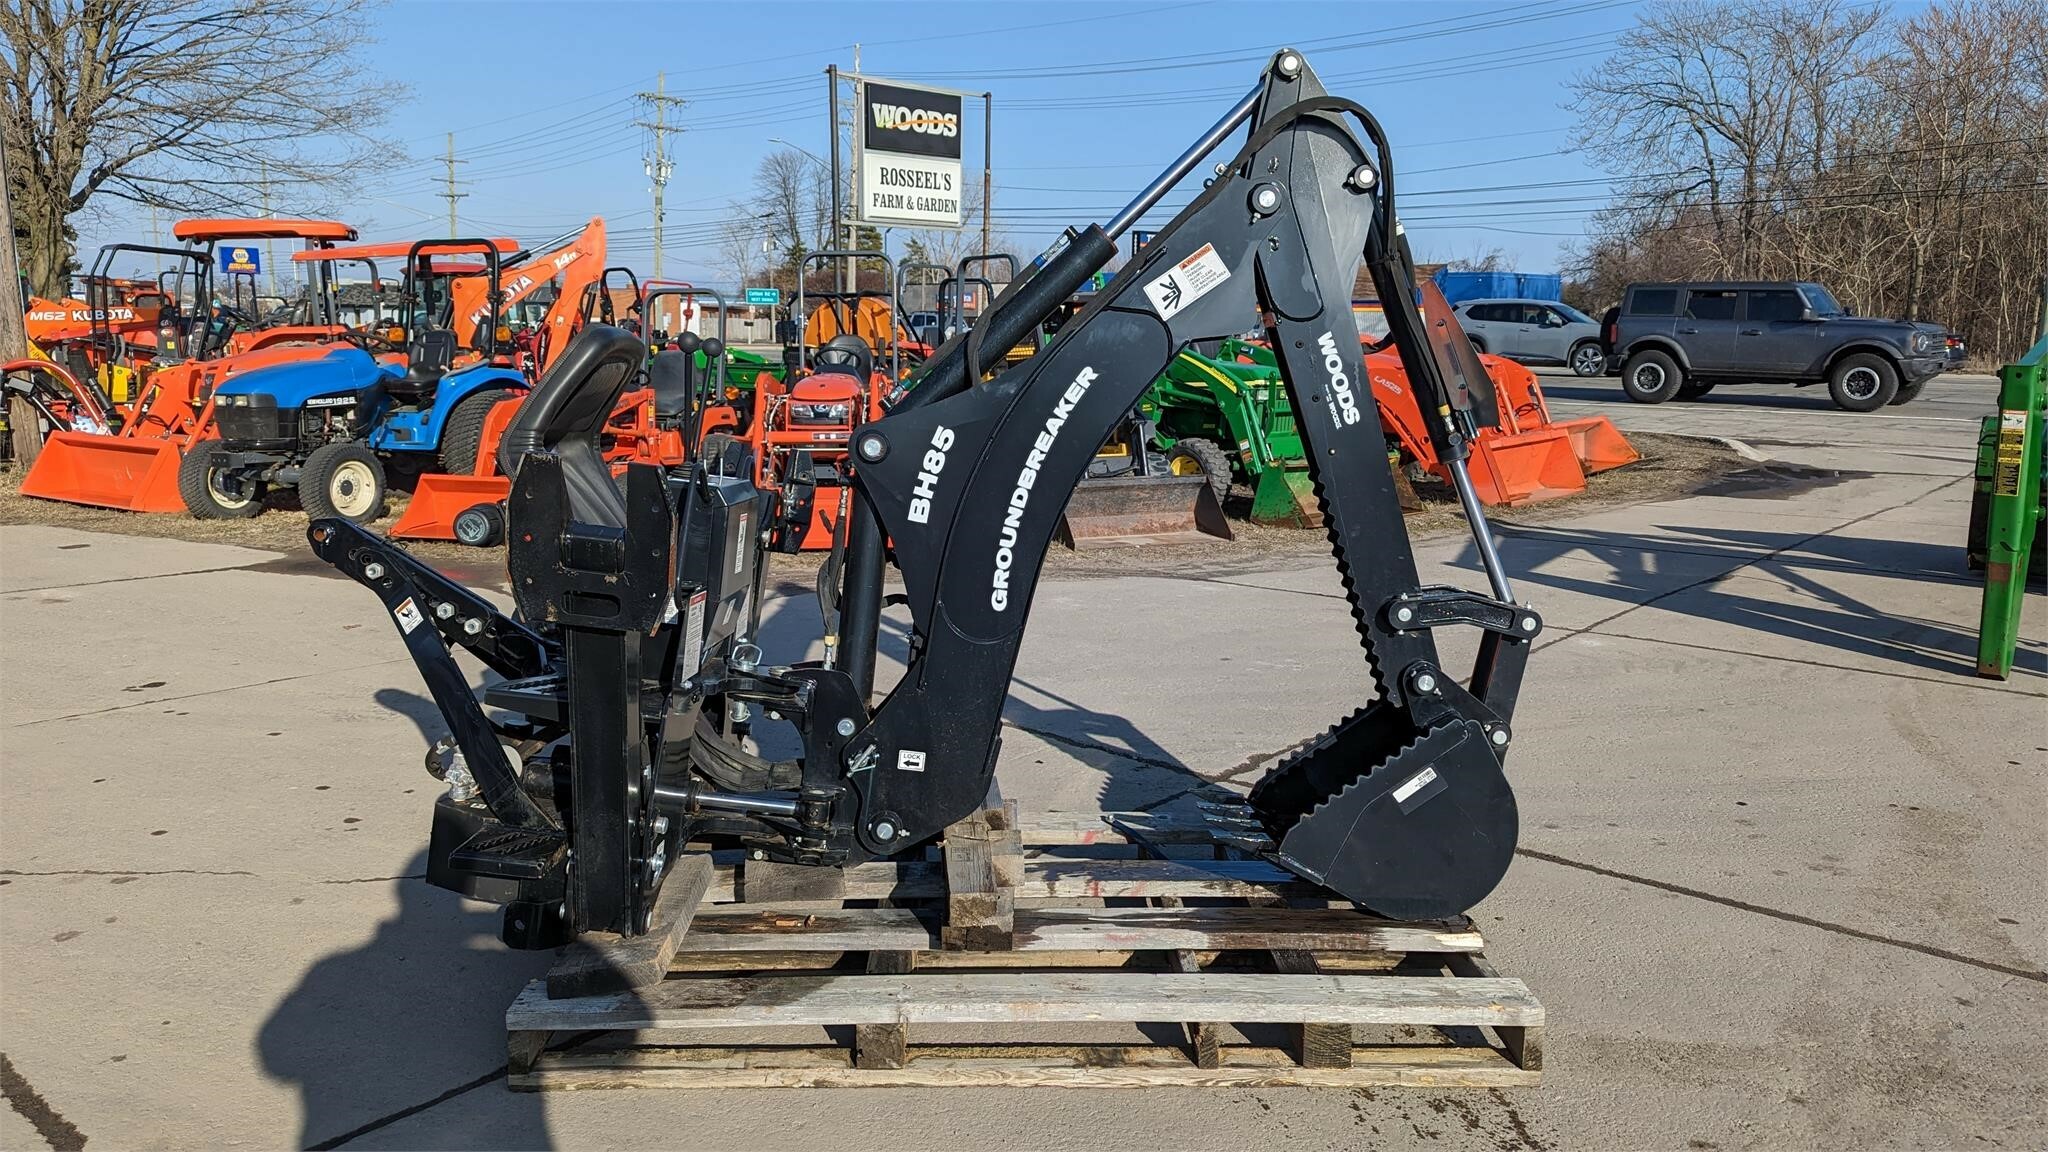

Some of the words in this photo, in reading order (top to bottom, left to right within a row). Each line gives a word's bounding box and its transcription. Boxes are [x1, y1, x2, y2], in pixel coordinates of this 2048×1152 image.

[872, 103, 957, 137] WOODS
[880, 167, 952, 191] ROSSEEL'S
[873, 193, 903, 209] FARM
[906, 195, 915, 210] &
[917, 196, 957, 213] GARDEN
[1186, 247, 1210, 265] WARNING
[470, 274, 534, 326] KUOTA
[30, 312, 65, 321] M62
[1317, 330, 1360, 425] WOODS
[333, 396, 356, 405] 1925
[907, 425, 956, 524] BH85
[991, 366, 1100, 612] GROUNDBREAKER
